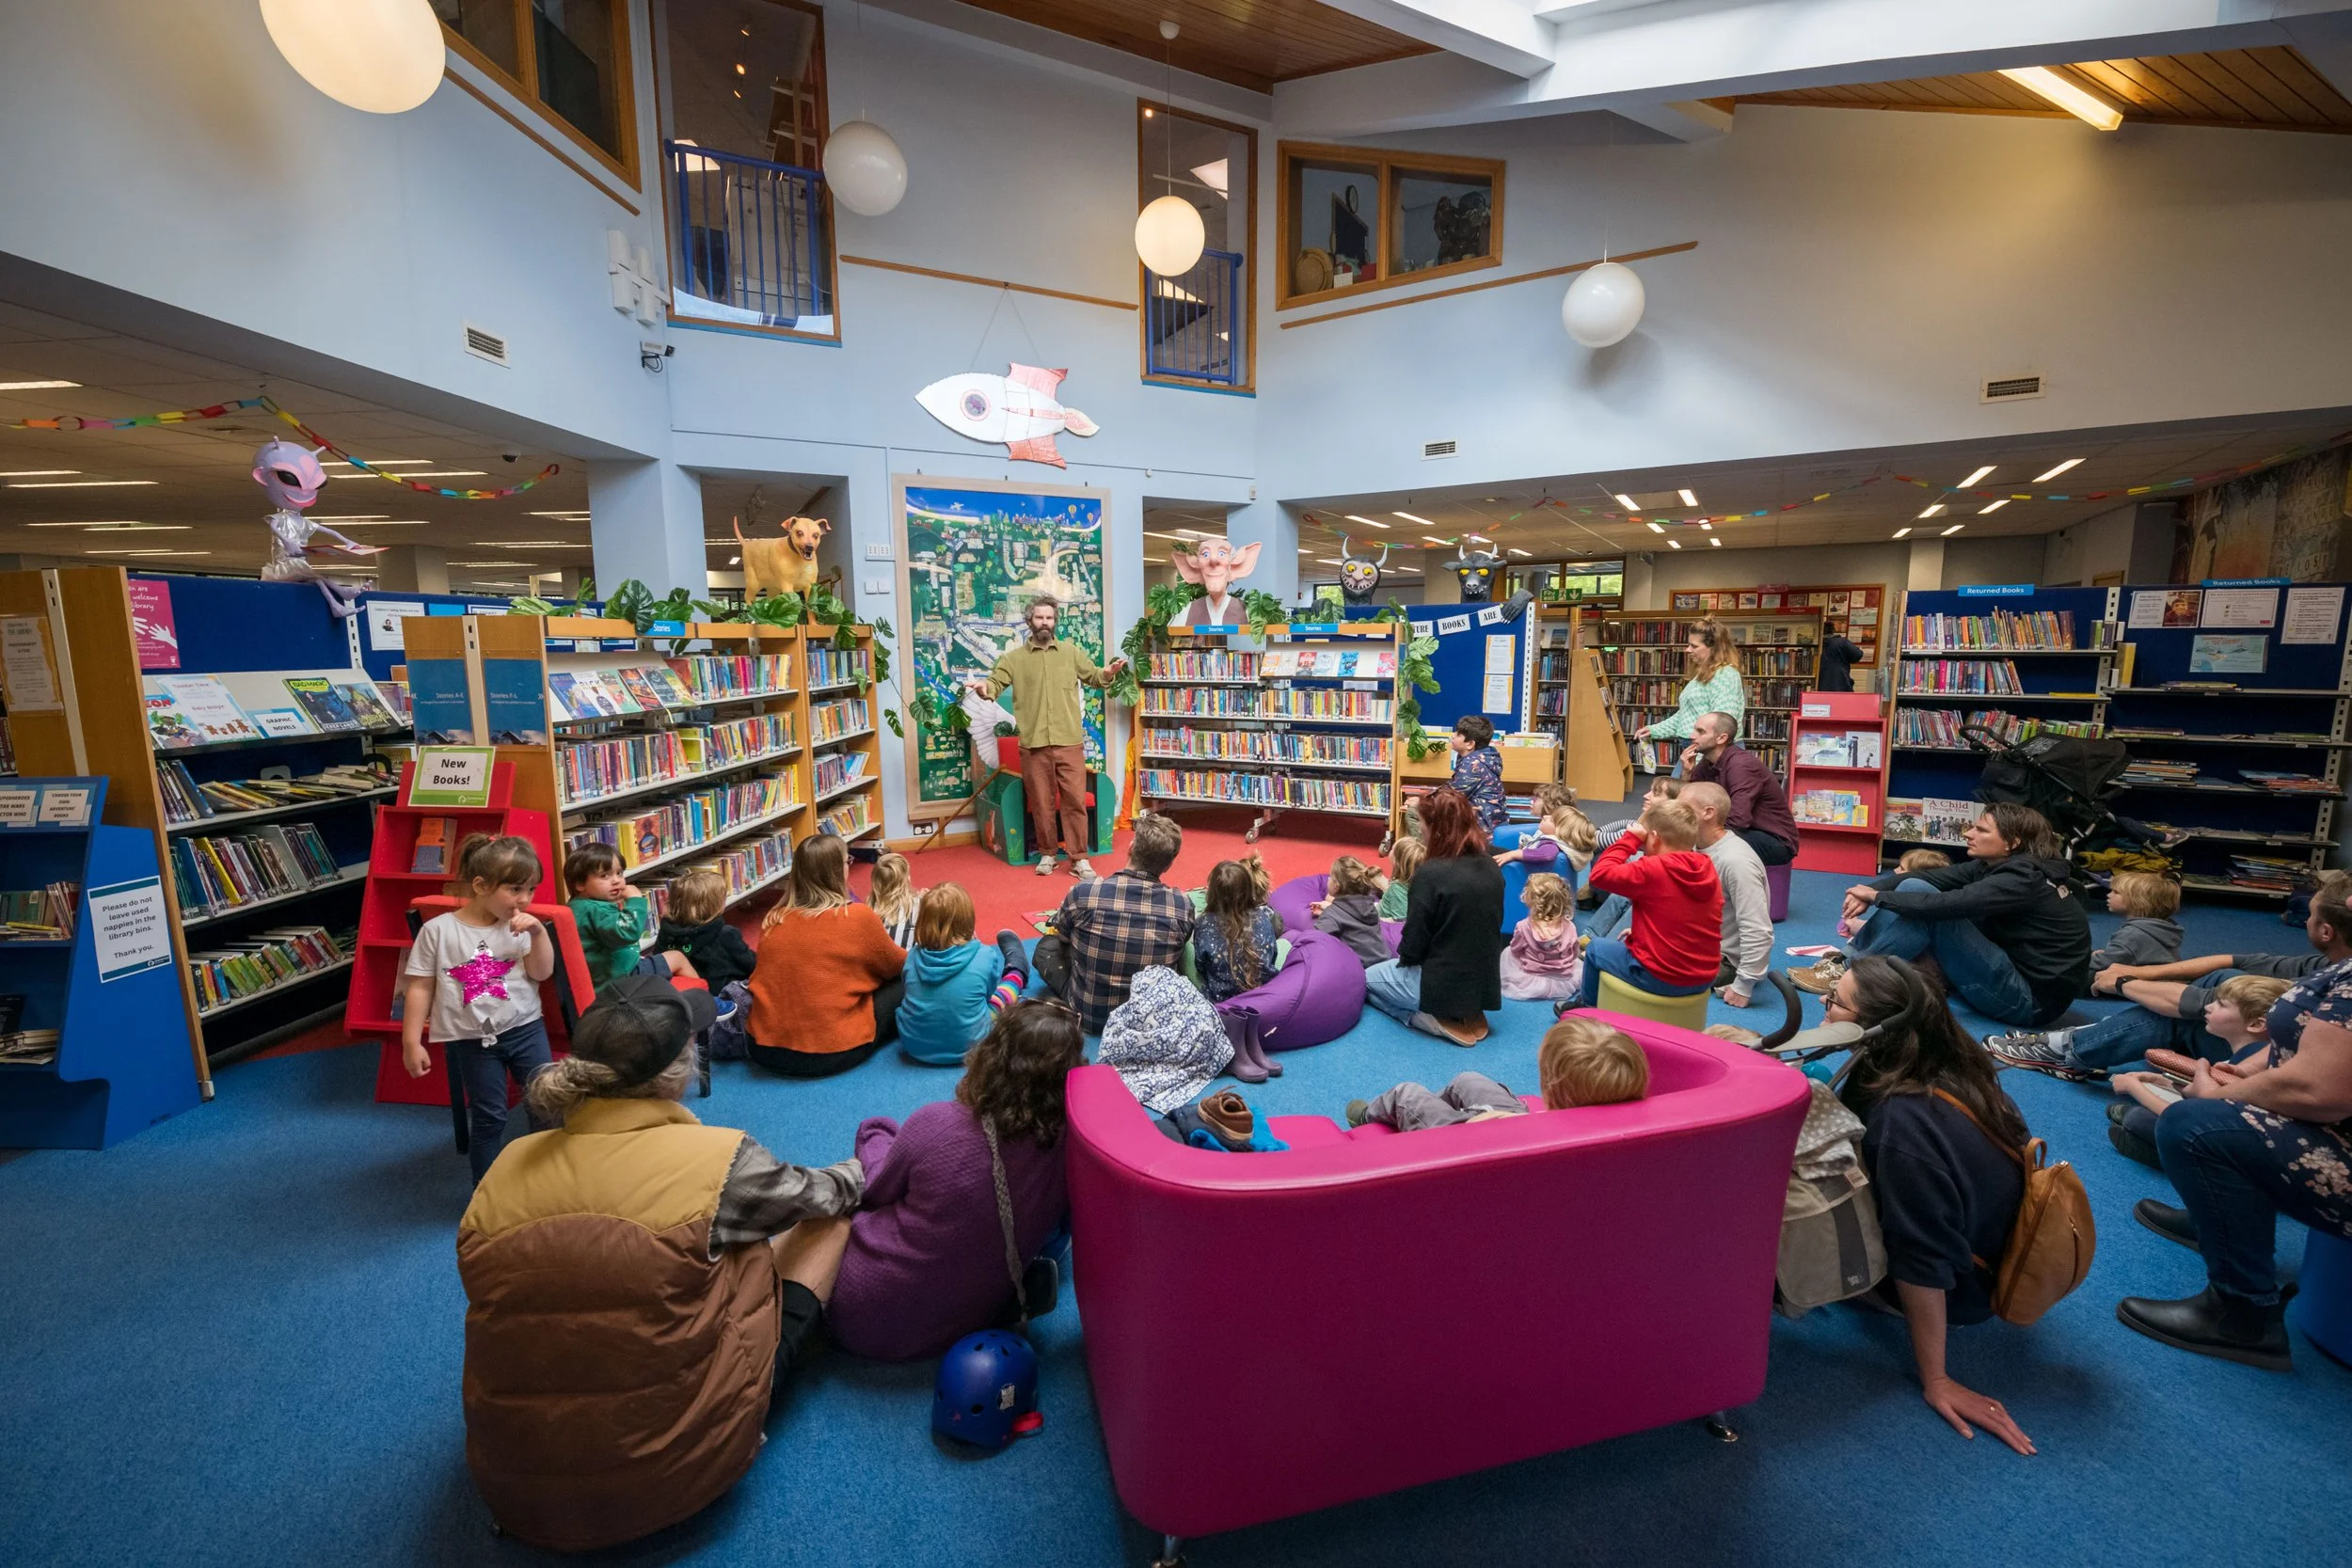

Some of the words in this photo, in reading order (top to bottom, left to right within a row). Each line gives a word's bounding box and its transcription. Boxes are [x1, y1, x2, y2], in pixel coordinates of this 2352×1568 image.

[132, 593, 159, 601] welcome
[131, 601, 154, 611] library
[1442, 619, 1466, 630] BOOKS
[1483, 610, 1498, 621] ARE
[653, 623, 671, 632] Stories
[440, 758, 467, 768] New
[433, 774, 470, 784] Books!
[1940, 800, 1969, 810] Child
[102, 902, 128, 912] Please
[109, 911, 130, 921] leave
[131, 906, 150, 916] used
[103, 920, 134, 932] nappies
[143, 914, 156, 923] the
[108, 930, 134, 941] library
[135, 926, 153, 934] bins.
[114, 948, 137, 958] Thank
[138, 943, 154, 954] you.
